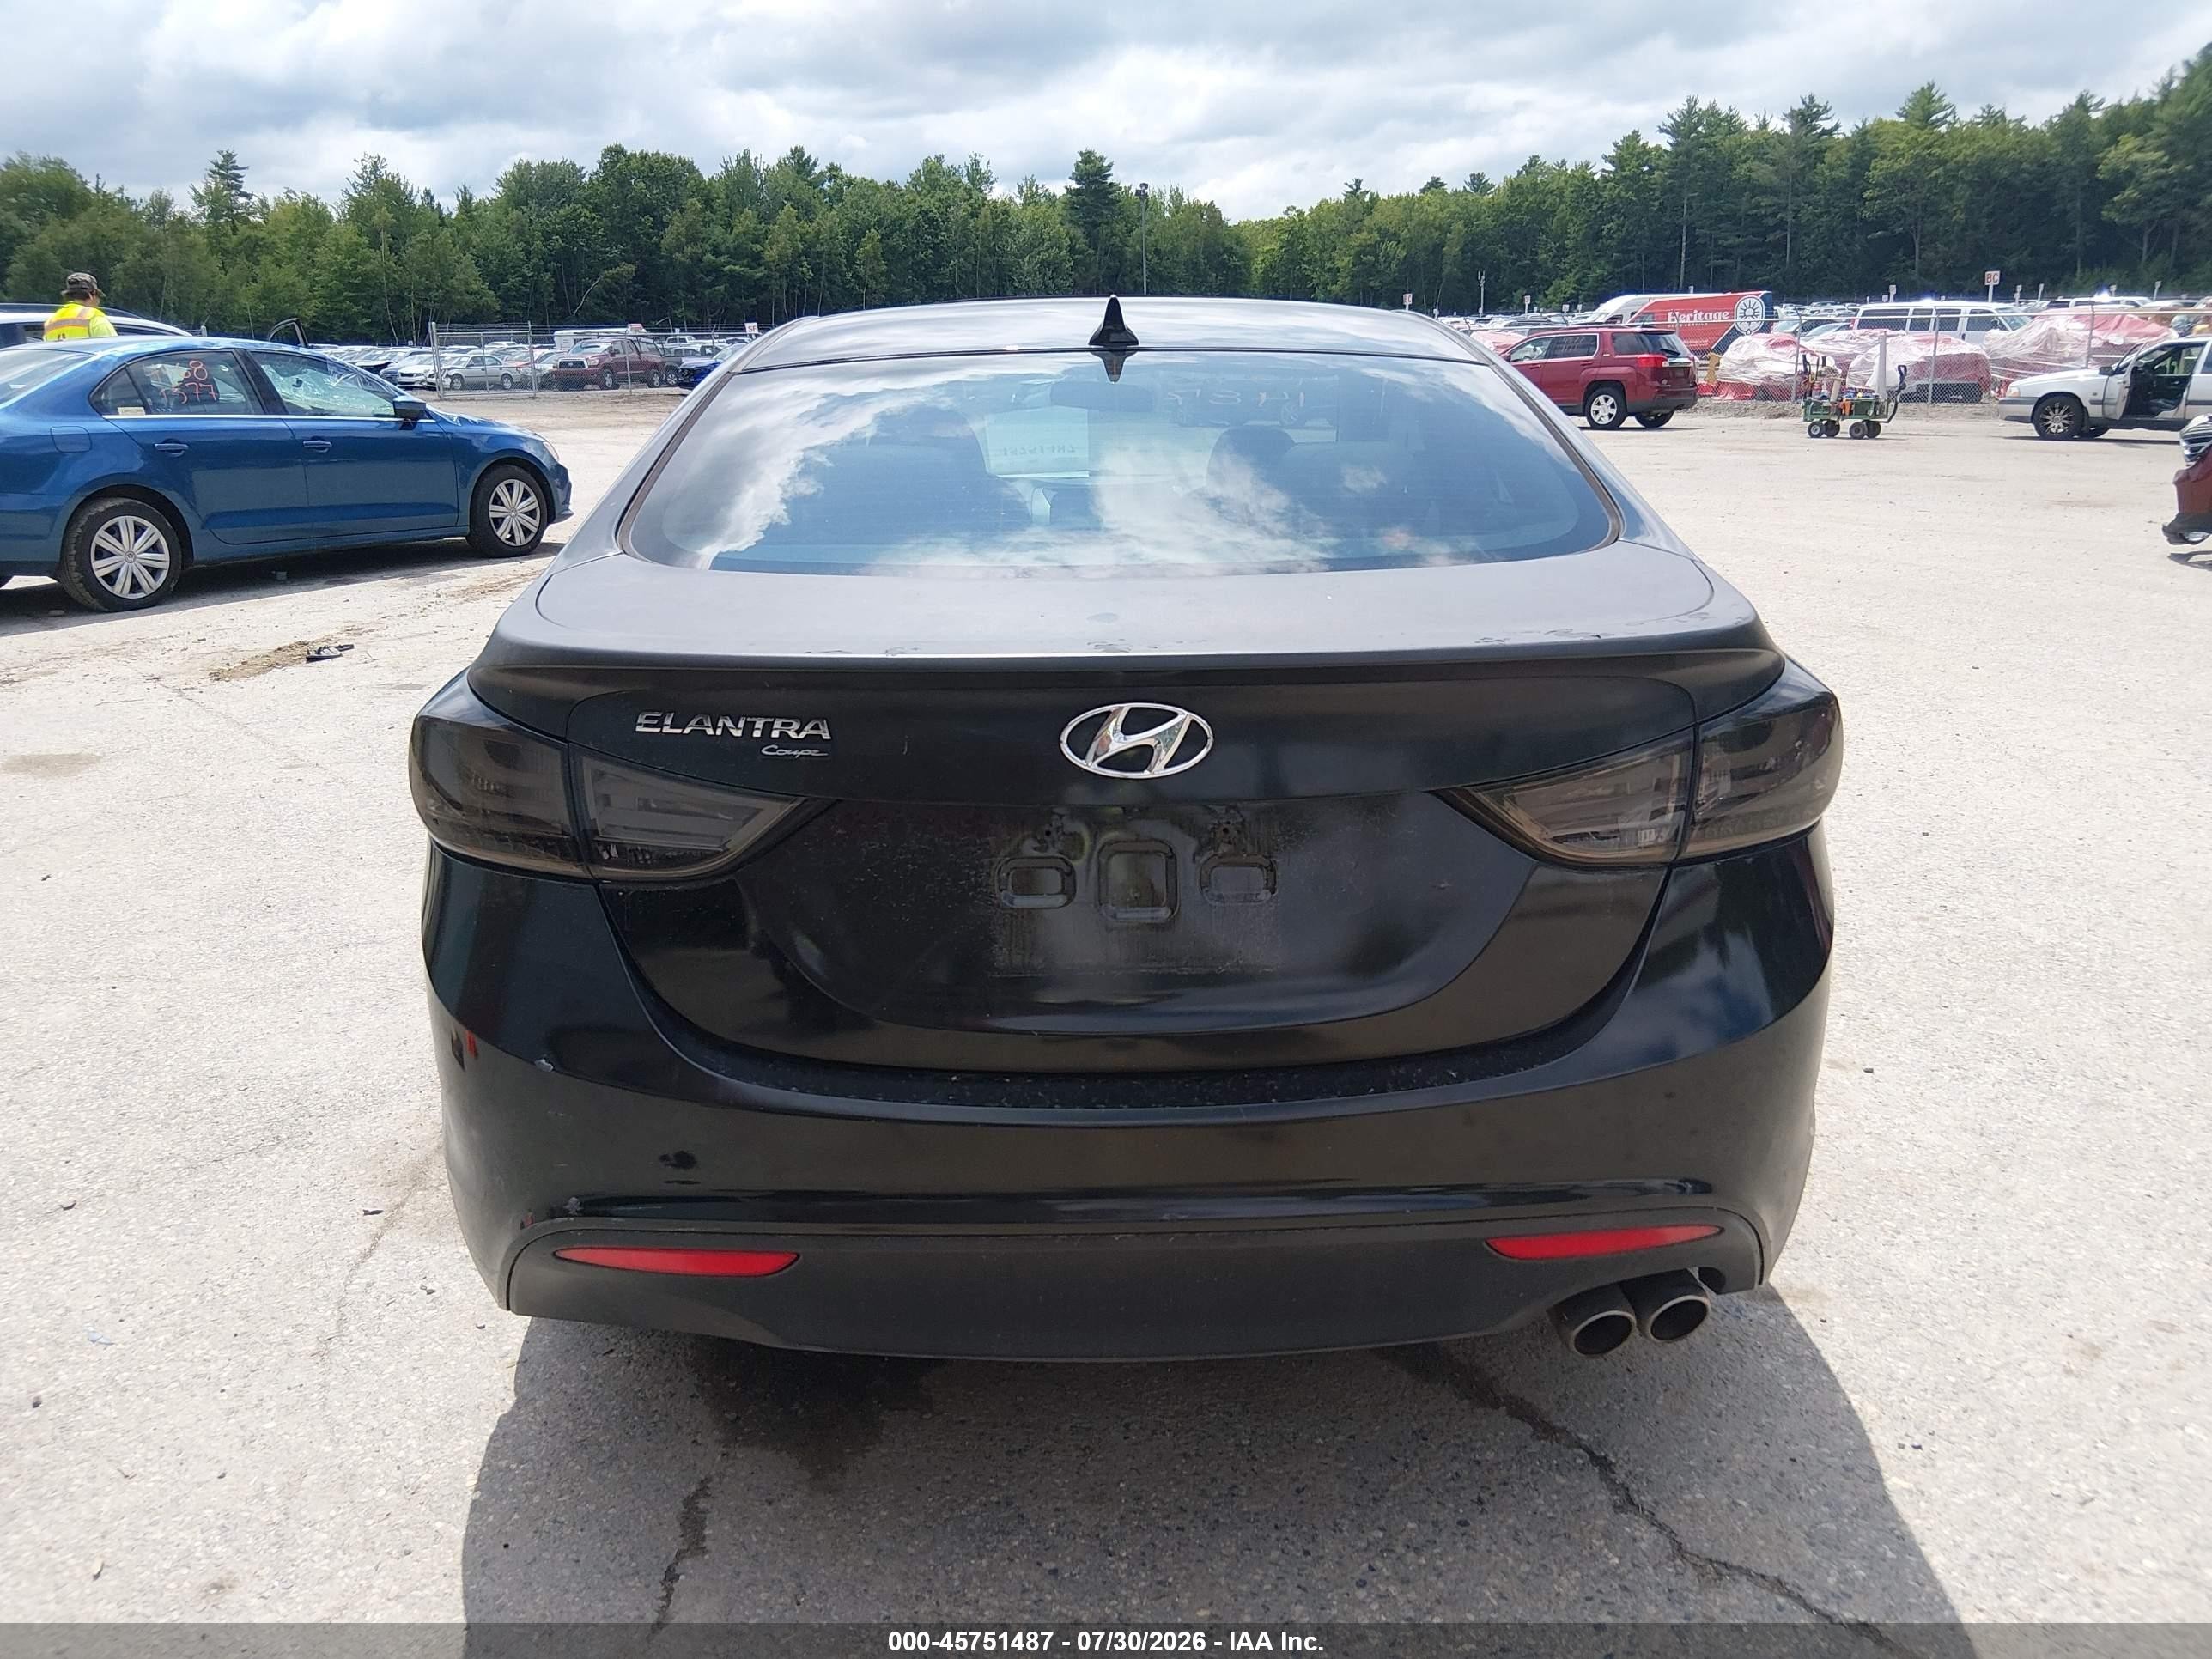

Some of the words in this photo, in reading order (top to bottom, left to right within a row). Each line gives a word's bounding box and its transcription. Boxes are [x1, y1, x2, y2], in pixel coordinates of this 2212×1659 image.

[1986, 273, 1998, 283] BC
[1668, 309, 1730, 323] Heritage
[635, 711, 832, 740] ELANTRA
[761, 744, 829, 758] Coupe
